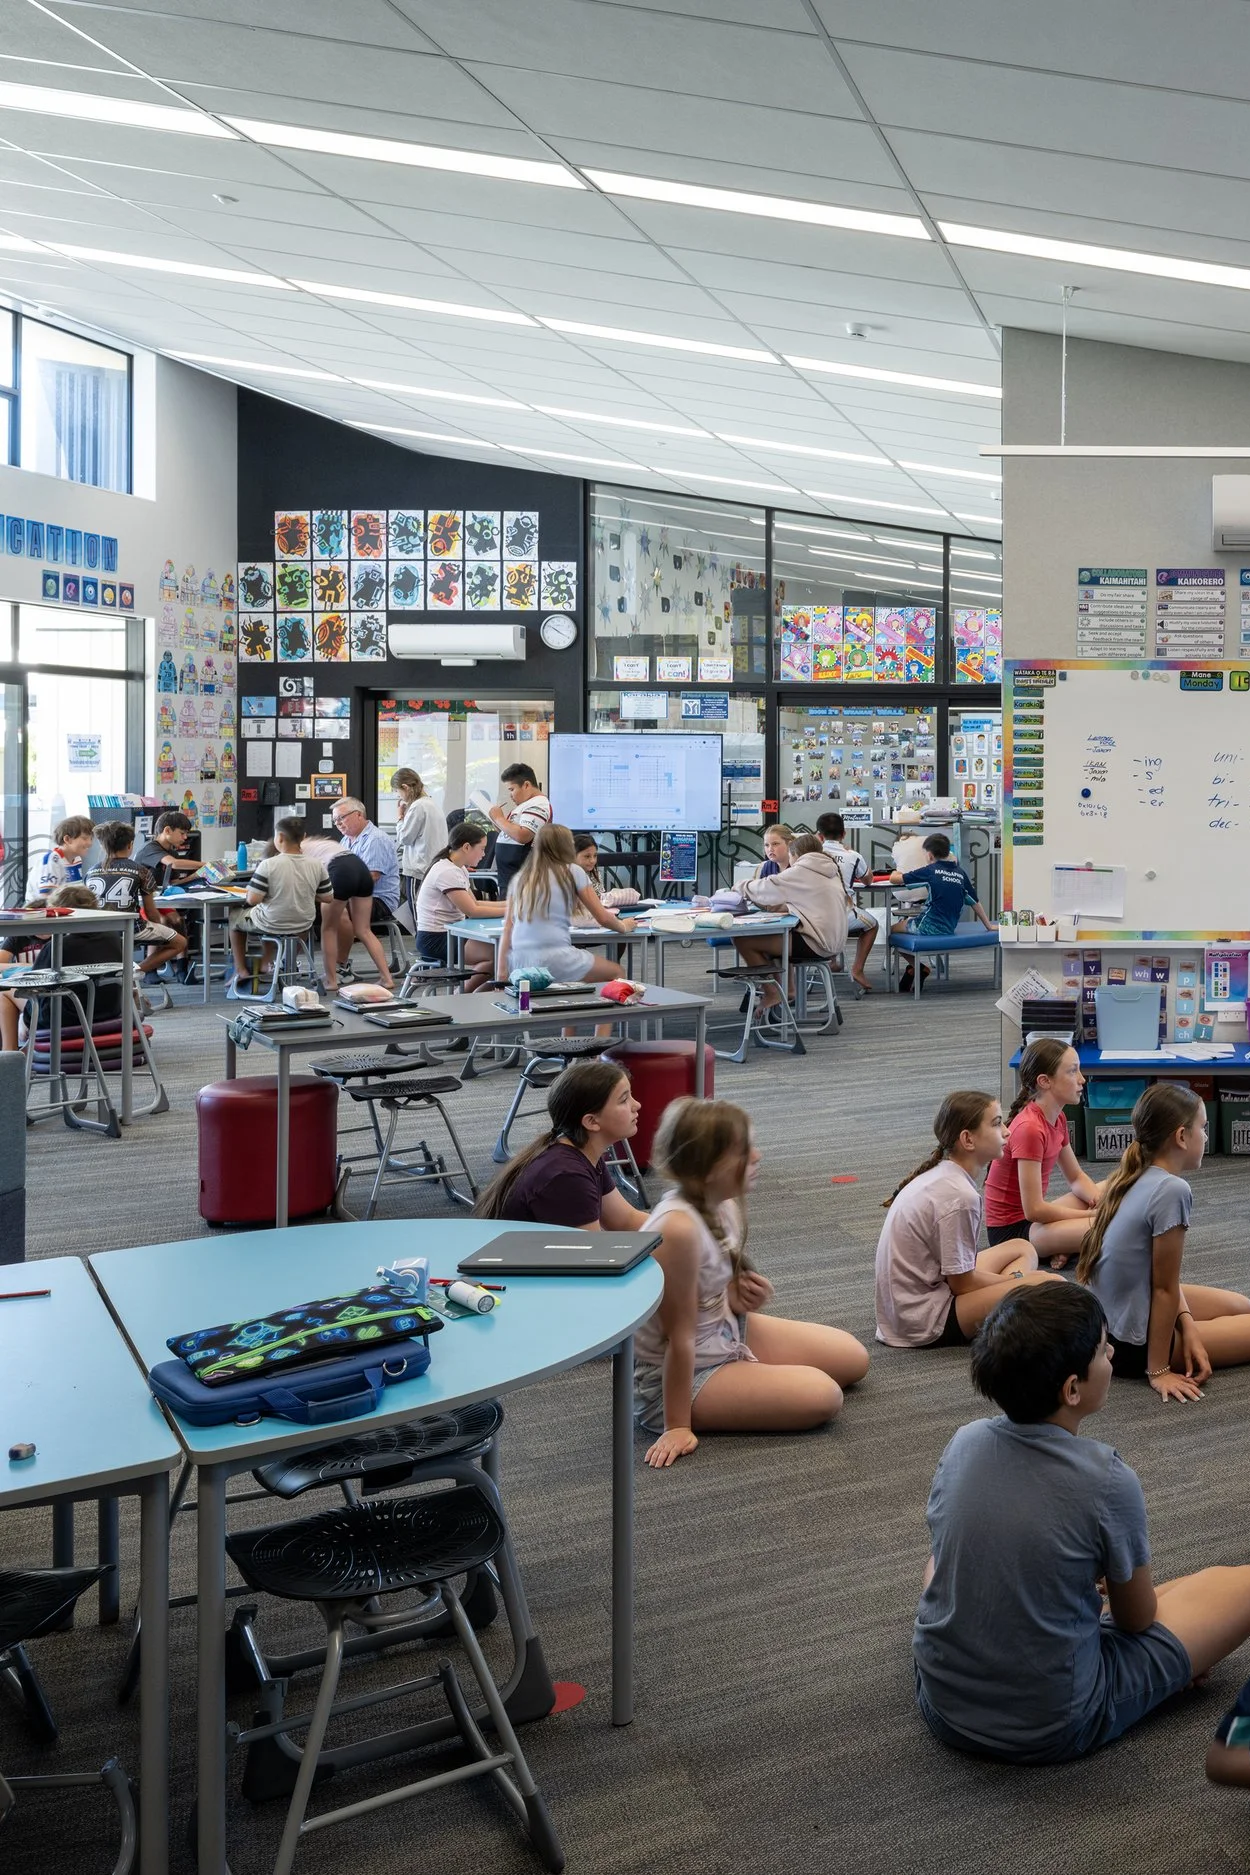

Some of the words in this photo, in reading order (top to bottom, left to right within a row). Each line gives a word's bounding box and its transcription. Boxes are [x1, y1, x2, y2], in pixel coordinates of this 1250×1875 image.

[10, 519, 118, 572] CATION
[1177, 578, 1224, 586] KAIKORERO
[1183, 679, 1220, 689] Monday
[761, 801, 772, 810] Rm
[772, 801, 778, 810] 2
[942, 875, 962, 885] SCHOOL
[86, 876, 136, 909] 24
[1134, 969, 1149, 978] wh
[1156, 971, 1164, 979] w
[1178, 1031, 1190, 1039] ch
